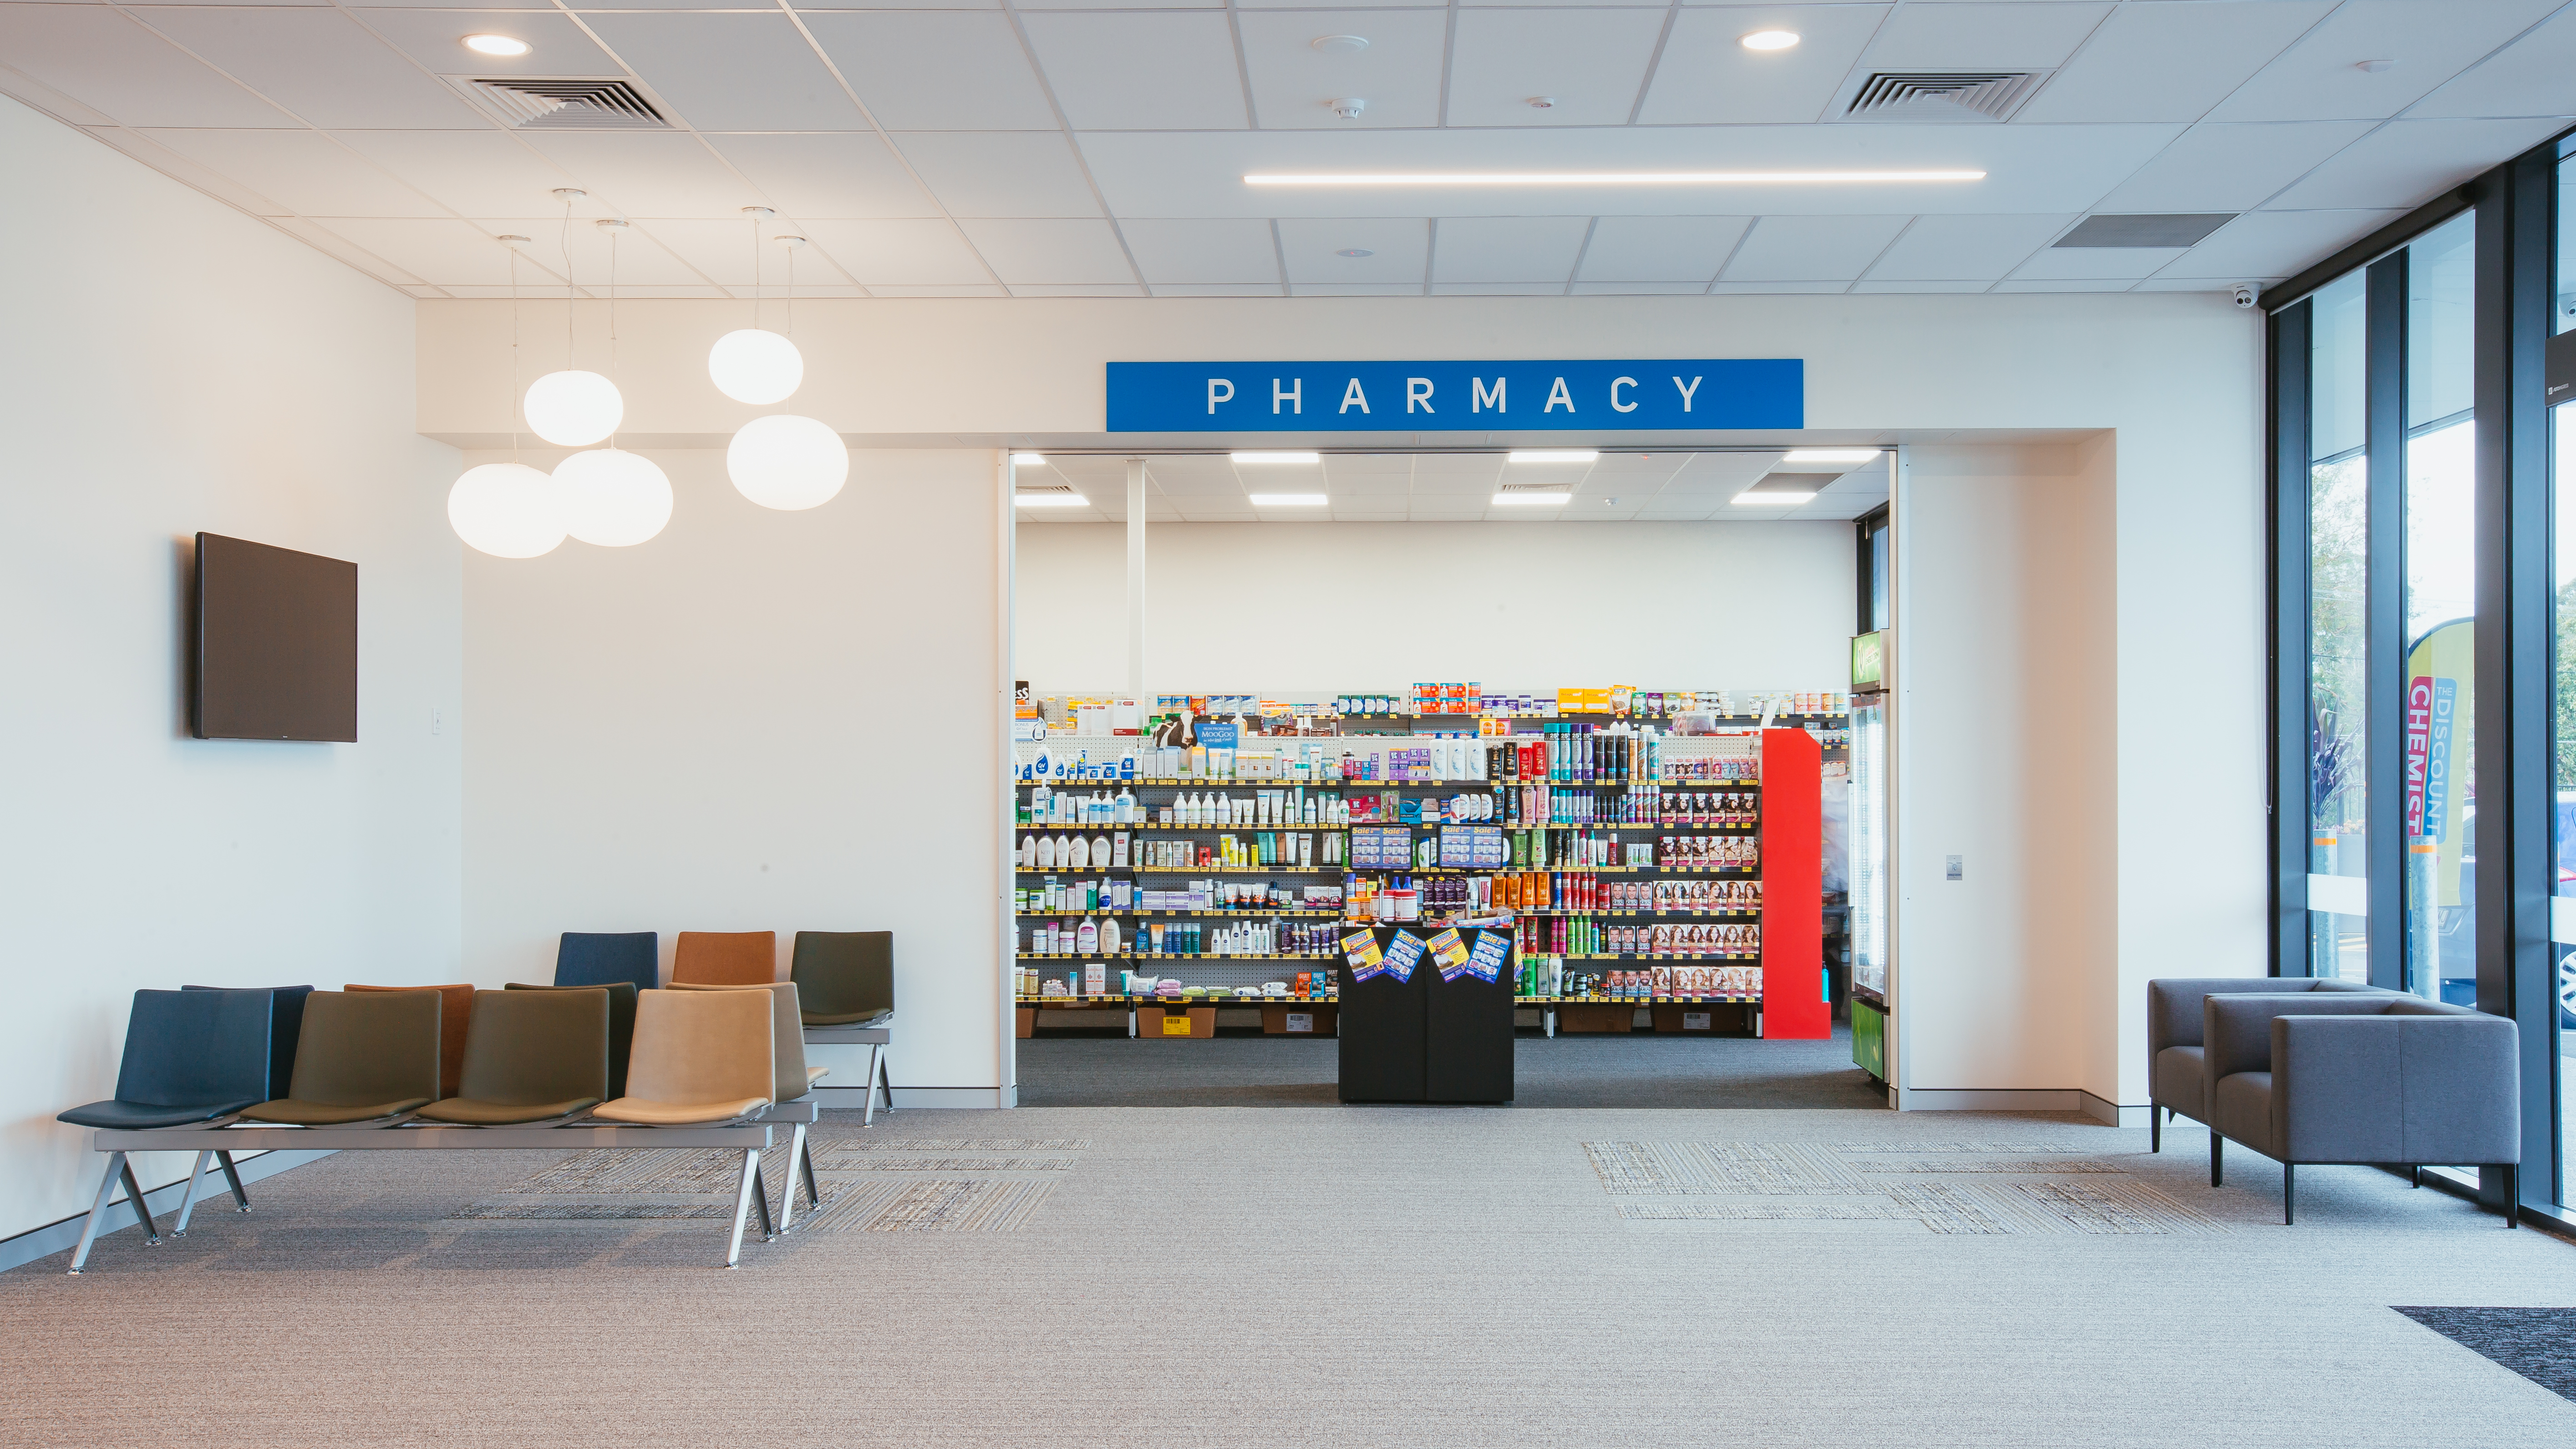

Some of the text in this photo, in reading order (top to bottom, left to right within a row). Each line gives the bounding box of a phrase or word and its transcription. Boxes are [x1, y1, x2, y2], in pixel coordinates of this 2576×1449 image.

[1208, 376, 1703, 414] PHARMACY
[2408, 685, 2430, 834] CHEMIST
[2425, 686, 2453, 835] THE DISCOUNT
[1348, 932, 1366, 942] DISCOUNT
[1348, 935, 1367, 946] CHEMIST
[1433, 931, 1451, 943] DISCOUNT
[1433, 935, 1453, 946] CHEMIST
